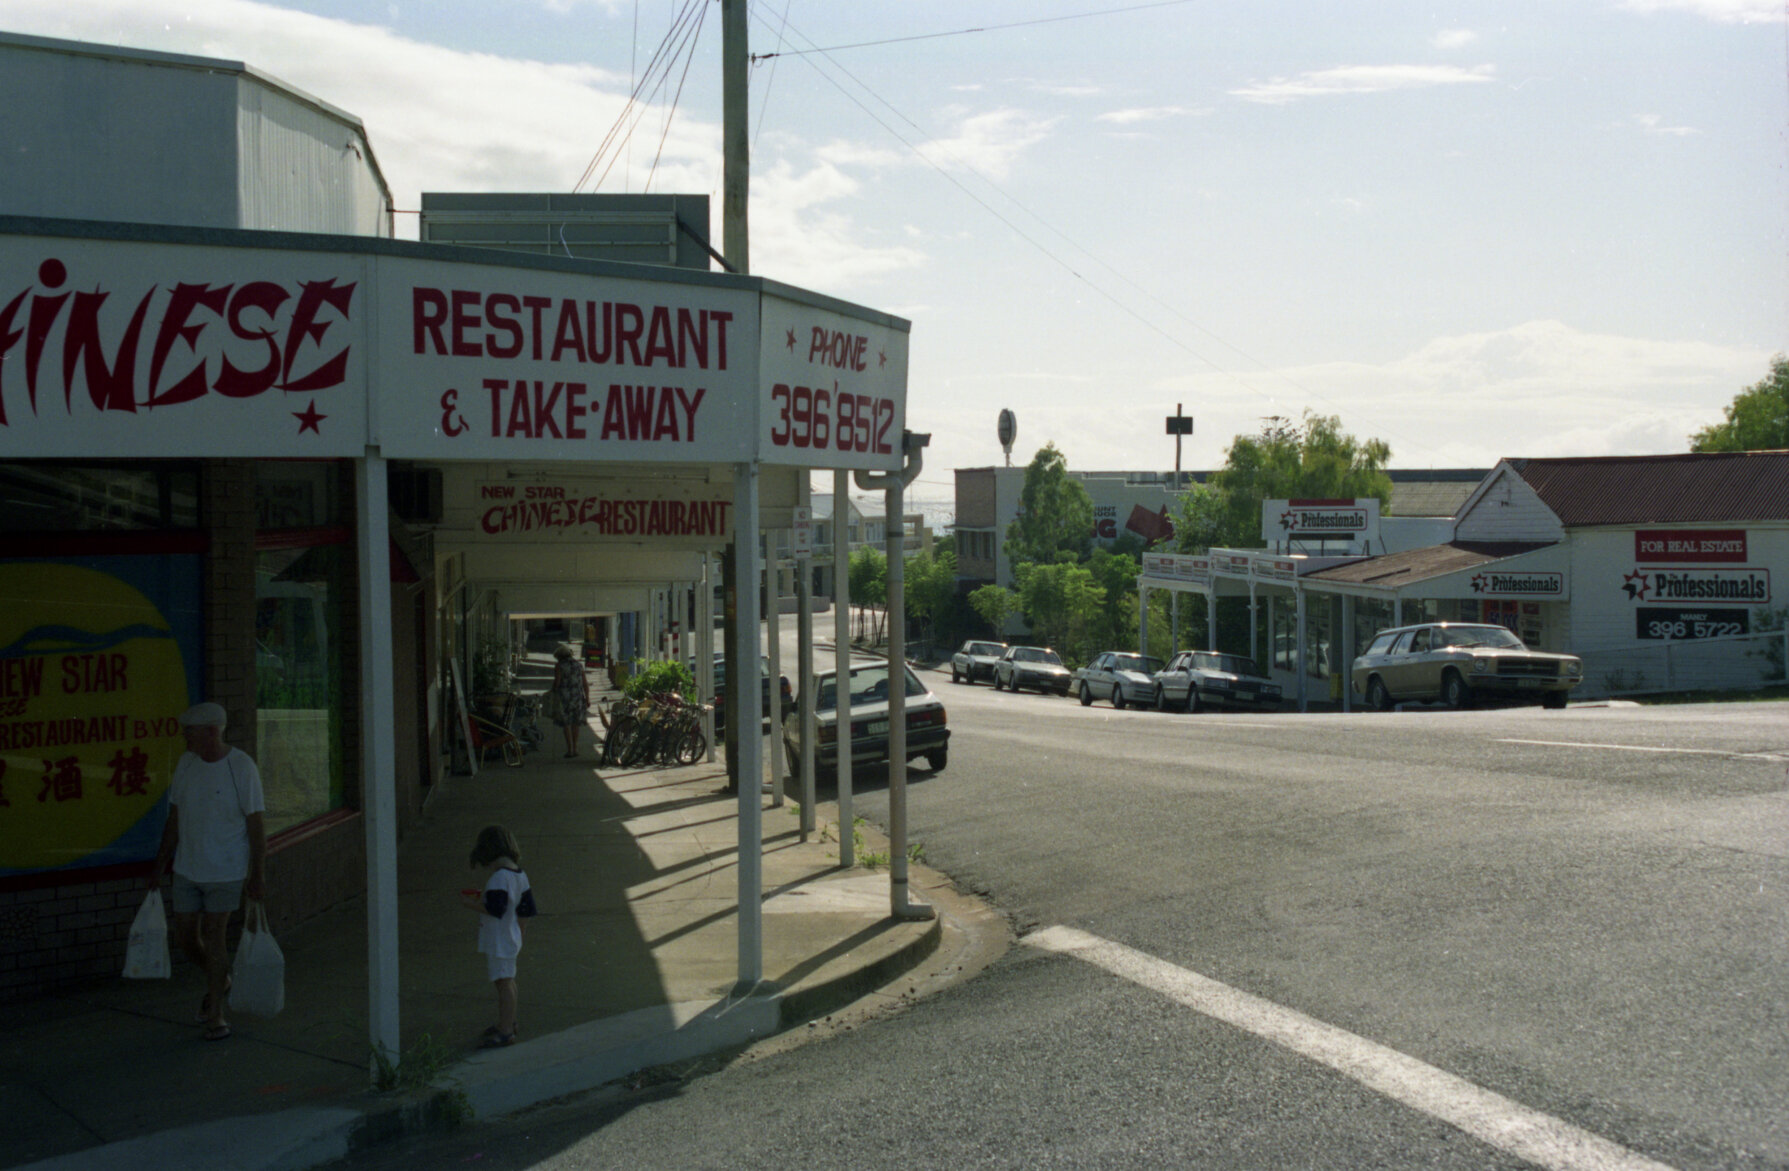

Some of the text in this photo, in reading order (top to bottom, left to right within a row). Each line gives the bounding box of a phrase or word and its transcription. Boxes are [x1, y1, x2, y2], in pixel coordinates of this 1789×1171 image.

[413, 287, 734, 371] RESTAURANT
[810, 326, 868, 370] PHONE
[440, 388, 469, 438] &
[482, 486, 564, 500] NEW STAR
[598, 500, 733, 536] RESTAURANT
[1301, 512, 1363, 528] Professionals
[1640, 541, 1742, 553] FOR REAL ESTATE
[1491, 574, 1558, 592] Professionals
[1655, 574, 1765, 598] Professionals
[1648, 621, 1741, 637] 396 5722
[1680, 613, 1707, 621] MANLY
[61, 653, 128, 694] STAR
[0, 714, 128, 751] RESTAURANT
